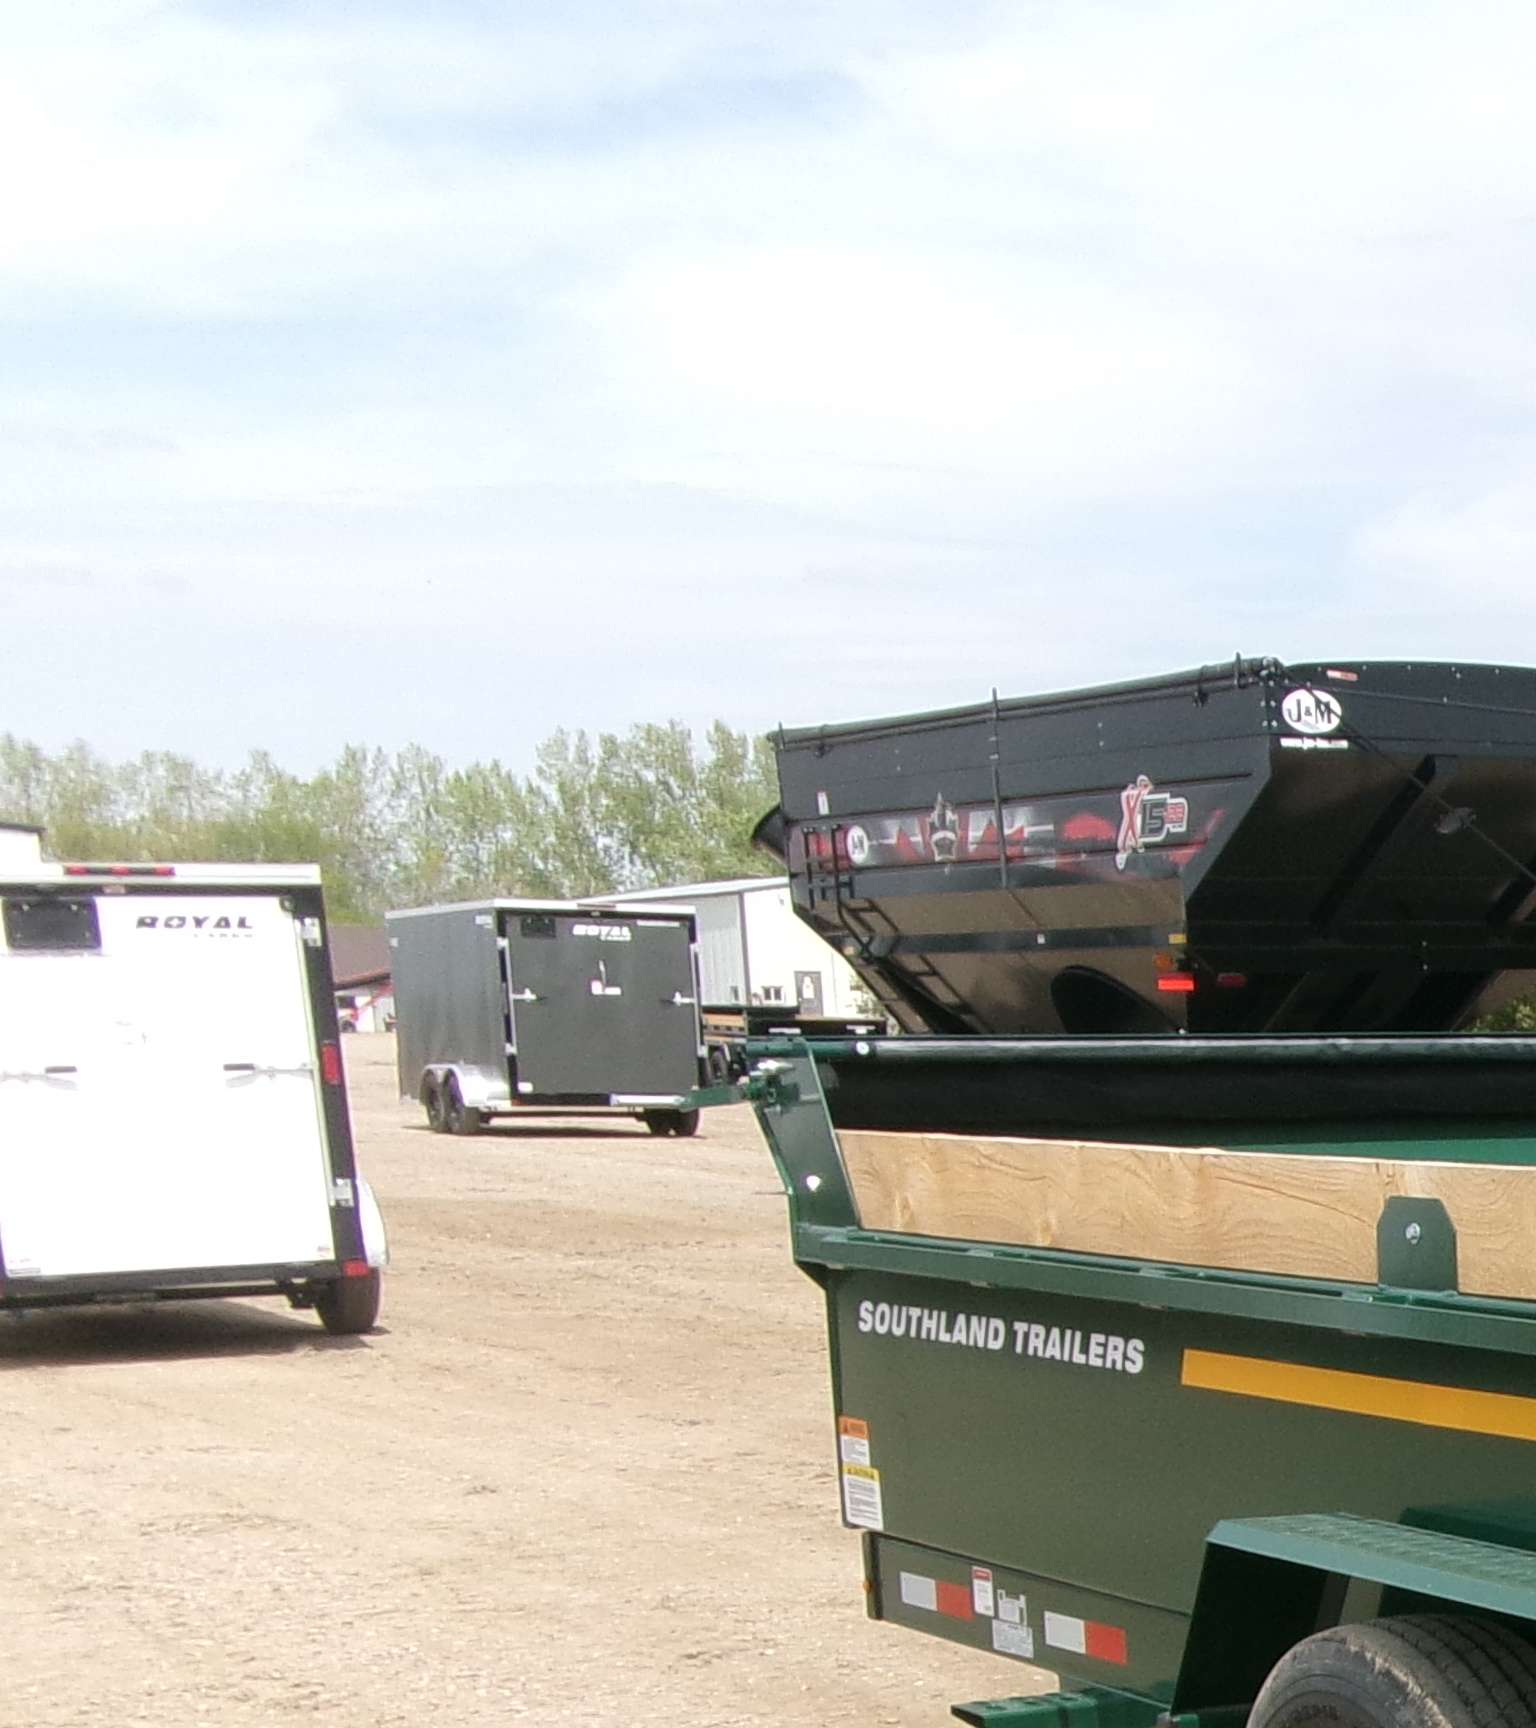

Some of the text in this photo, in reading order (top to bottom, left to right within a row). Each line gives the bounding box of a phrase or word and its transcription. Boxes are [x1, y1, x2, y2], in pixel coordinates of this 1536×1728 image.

[1286, 698, 1332, 725] J&M
[135, 915, 253, 929] ROYAL
[858, 1300, 1146, 1375] SOUTHLAND TRAILERS
